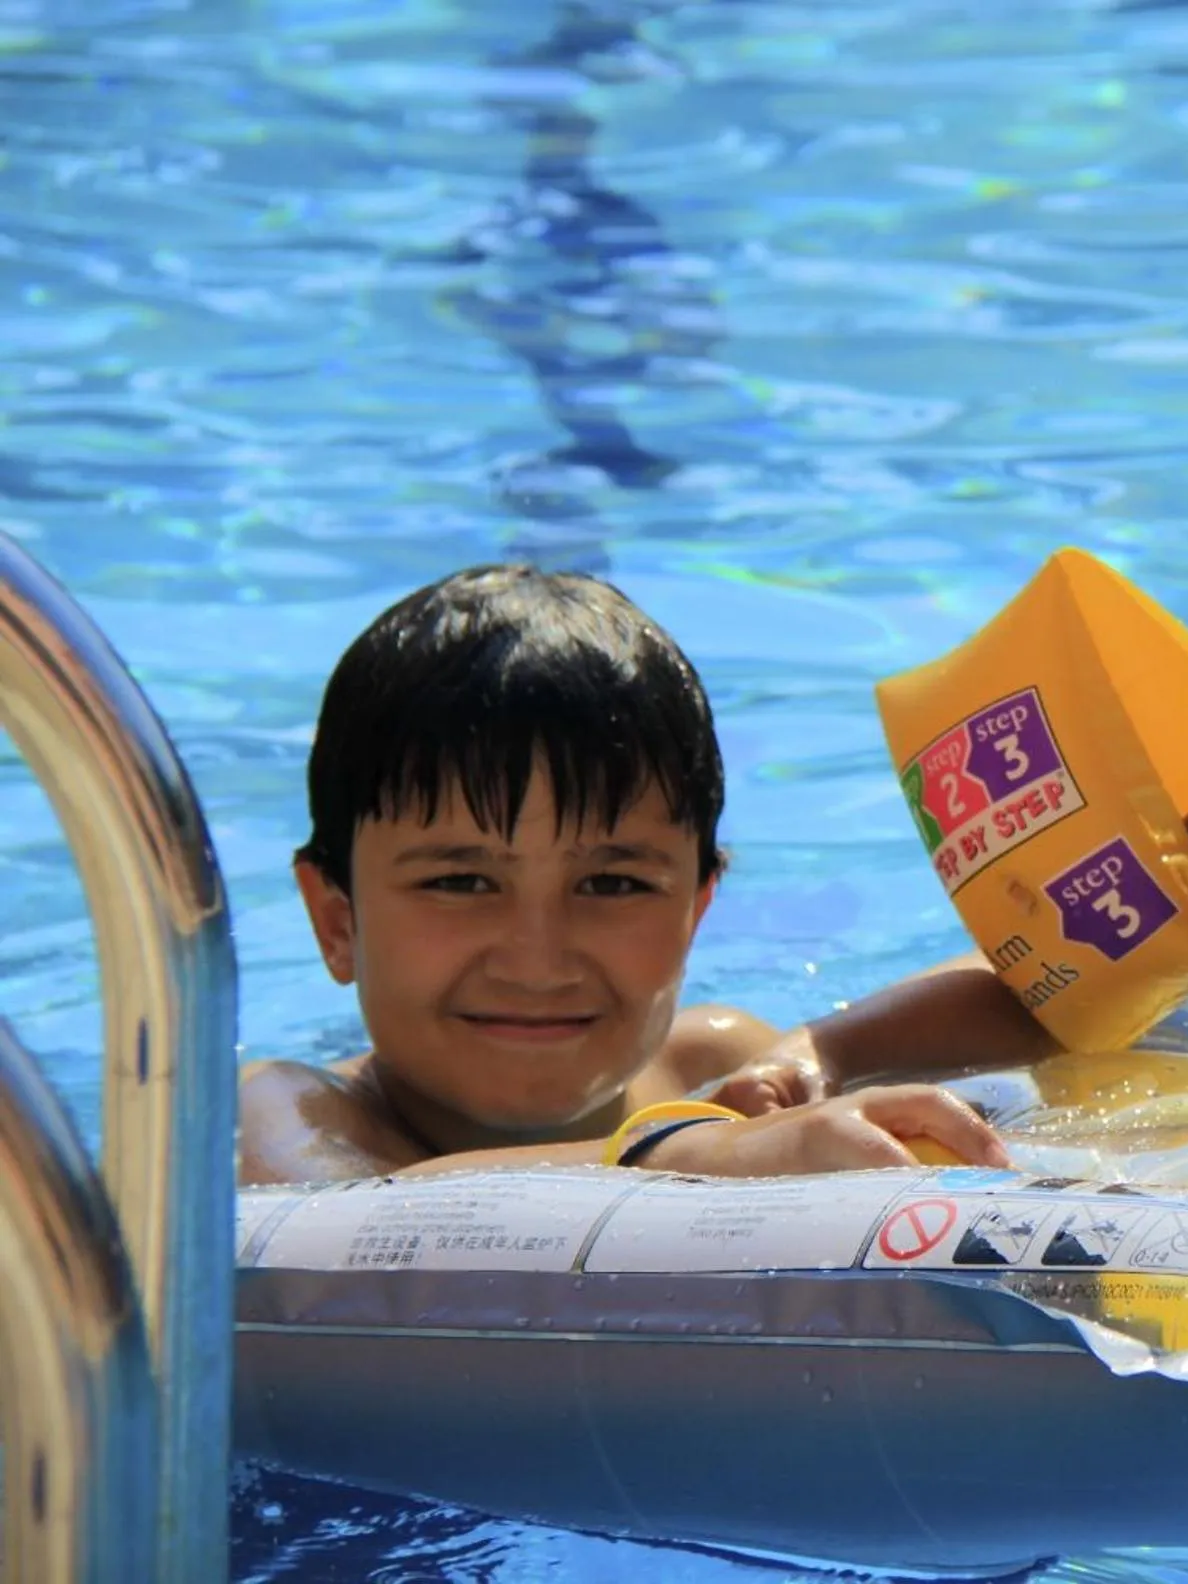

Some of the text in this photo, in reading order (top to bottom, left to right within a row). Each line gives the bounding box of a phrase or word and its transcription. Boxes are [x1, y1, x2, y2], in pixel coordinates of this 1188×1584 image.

[976, 704, 1028, 741] step
[926, 739, 960, 774] step
[994, 733, 1030, 781] 3
[940, 773, 966, 818] 2
[958, 825, 988, 862] BY
[991, 779, 1066, 841] STEP
[1061, 854, 1123, 907] step
[1091, 888, 1142, 939] 3
[1021, 961, 1080, 1009] ands
